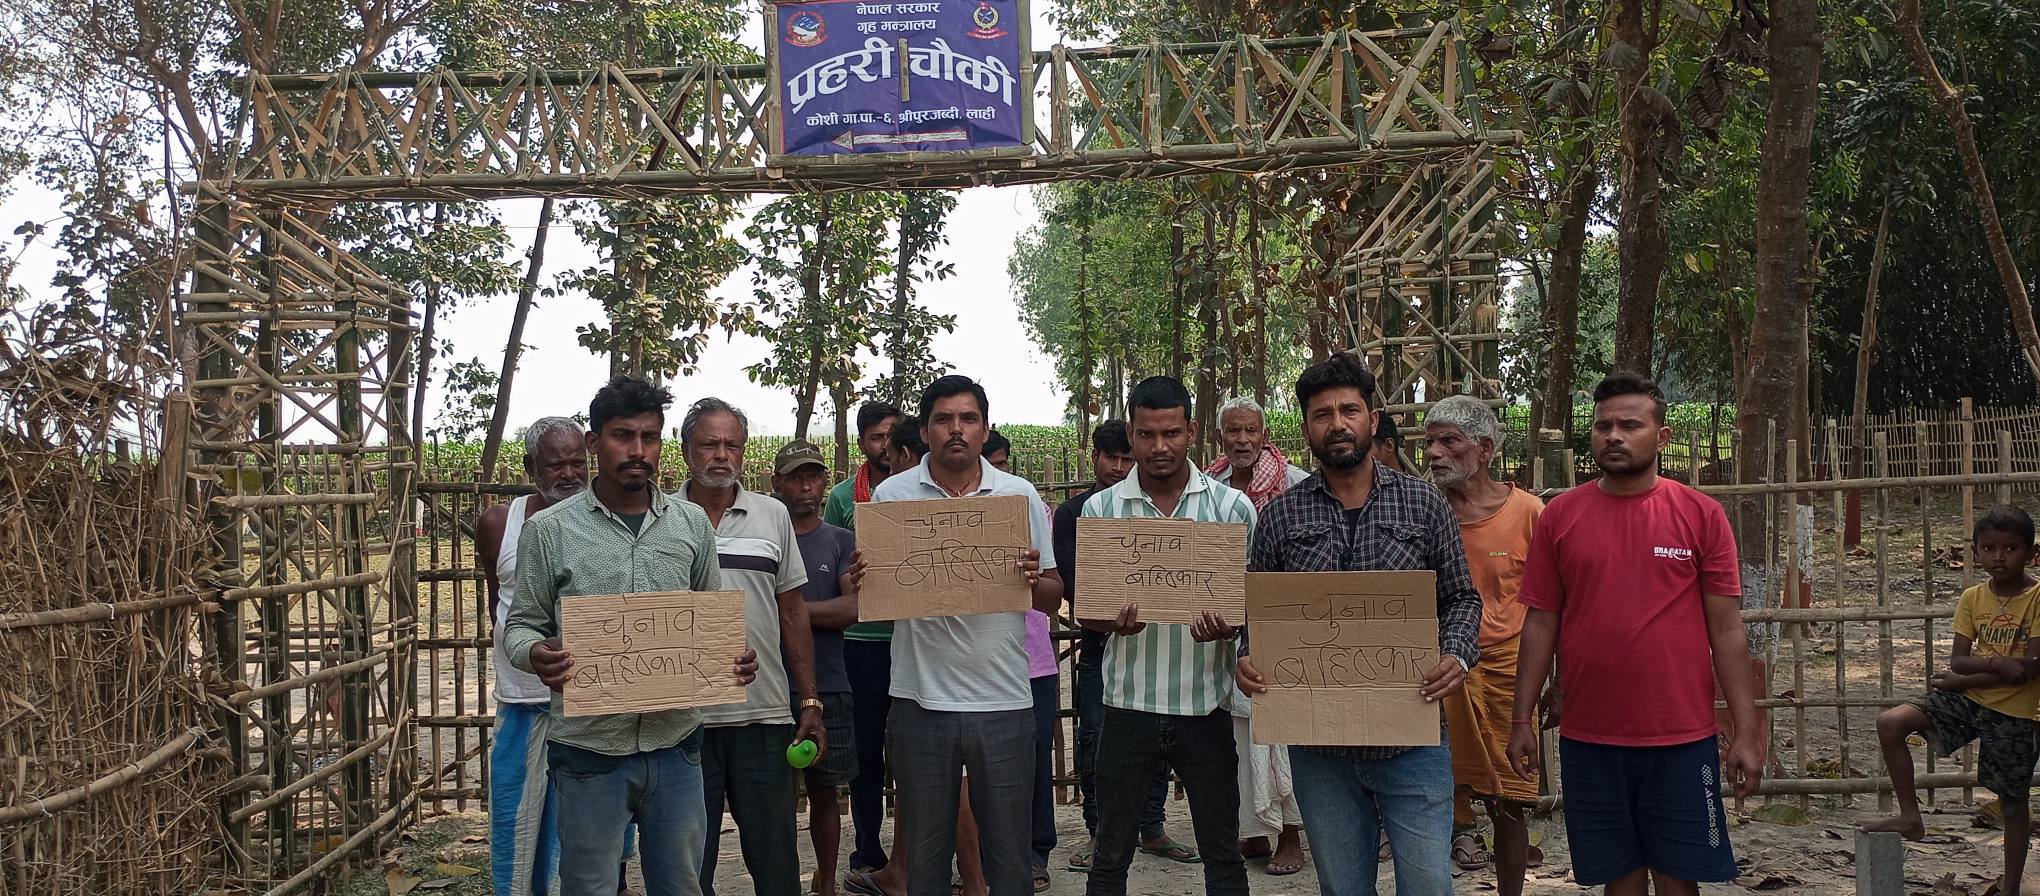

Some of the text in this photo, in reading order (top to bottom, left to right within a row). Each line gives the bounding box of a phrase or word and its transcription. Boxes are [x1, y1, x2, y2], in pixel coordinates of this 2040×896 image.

[856, 3, 941, 15] नेपाल सरकार
[857, 20, 936, 35] गृह मन्त्रालय
[787, 37, 1016, 114] प्रहरी चौकी
[806, 112, 839, 126] कोशी
[966, 106, 996, 120] लाही
[905, 510, 986, 539] चुनाव
[895, 539, 1028, 587] बहिष्का
[1109, 533, 1186, 565] चुनाव
[1125, 564, 1217, 598] बहिष्कार
[586, 606, 697, 655] चुनाव
[1263, 593, 1413, 646] चुनाव
